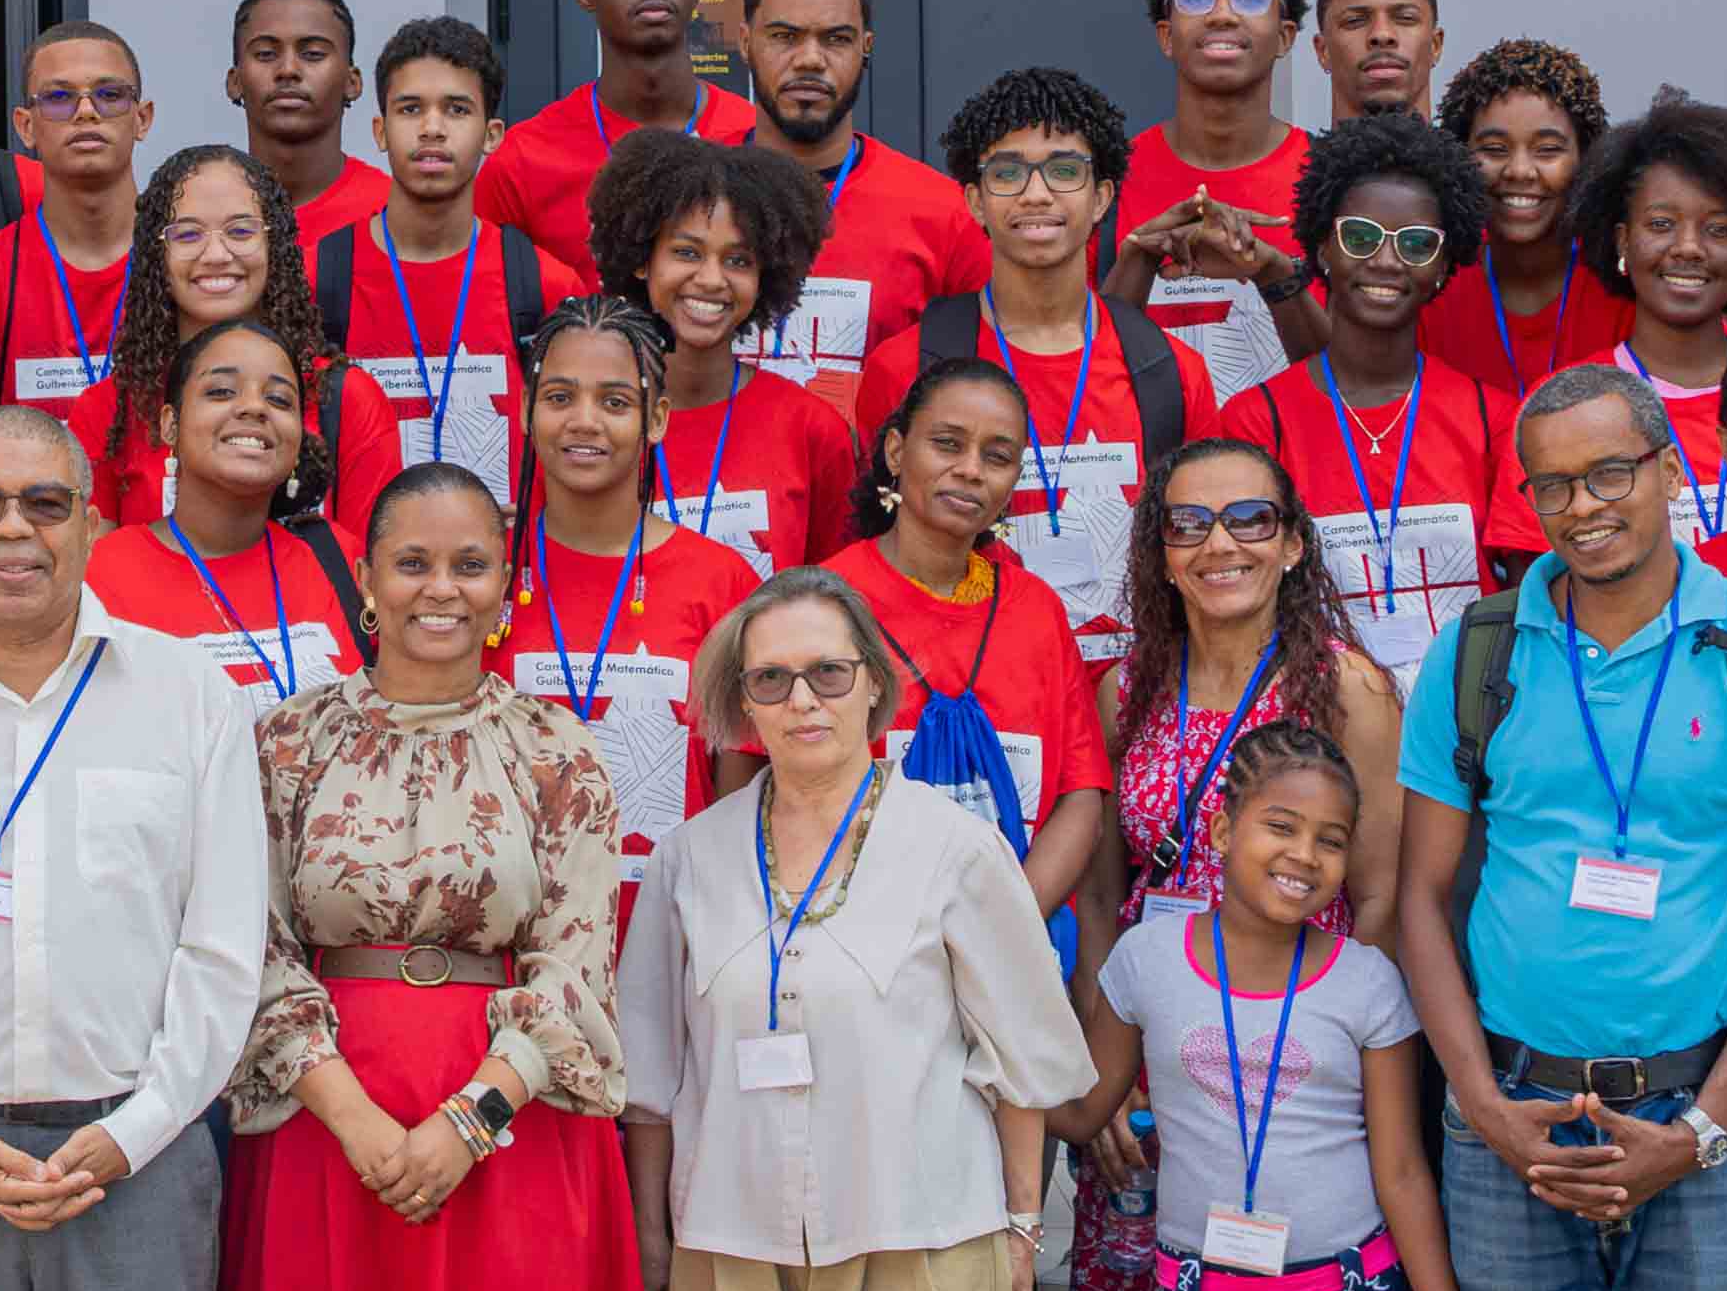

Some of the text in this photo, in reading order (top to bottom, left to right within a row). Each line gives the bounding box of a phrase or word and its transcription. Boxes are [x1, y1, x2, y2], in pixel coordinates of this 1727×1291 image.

[802, 287, 857, 299] atemática
[1164, 285, 1226, 297] Gulbenkian
[1321, 522, 1369, 537] Campos
[605, 661, 675, 678] Matemática
